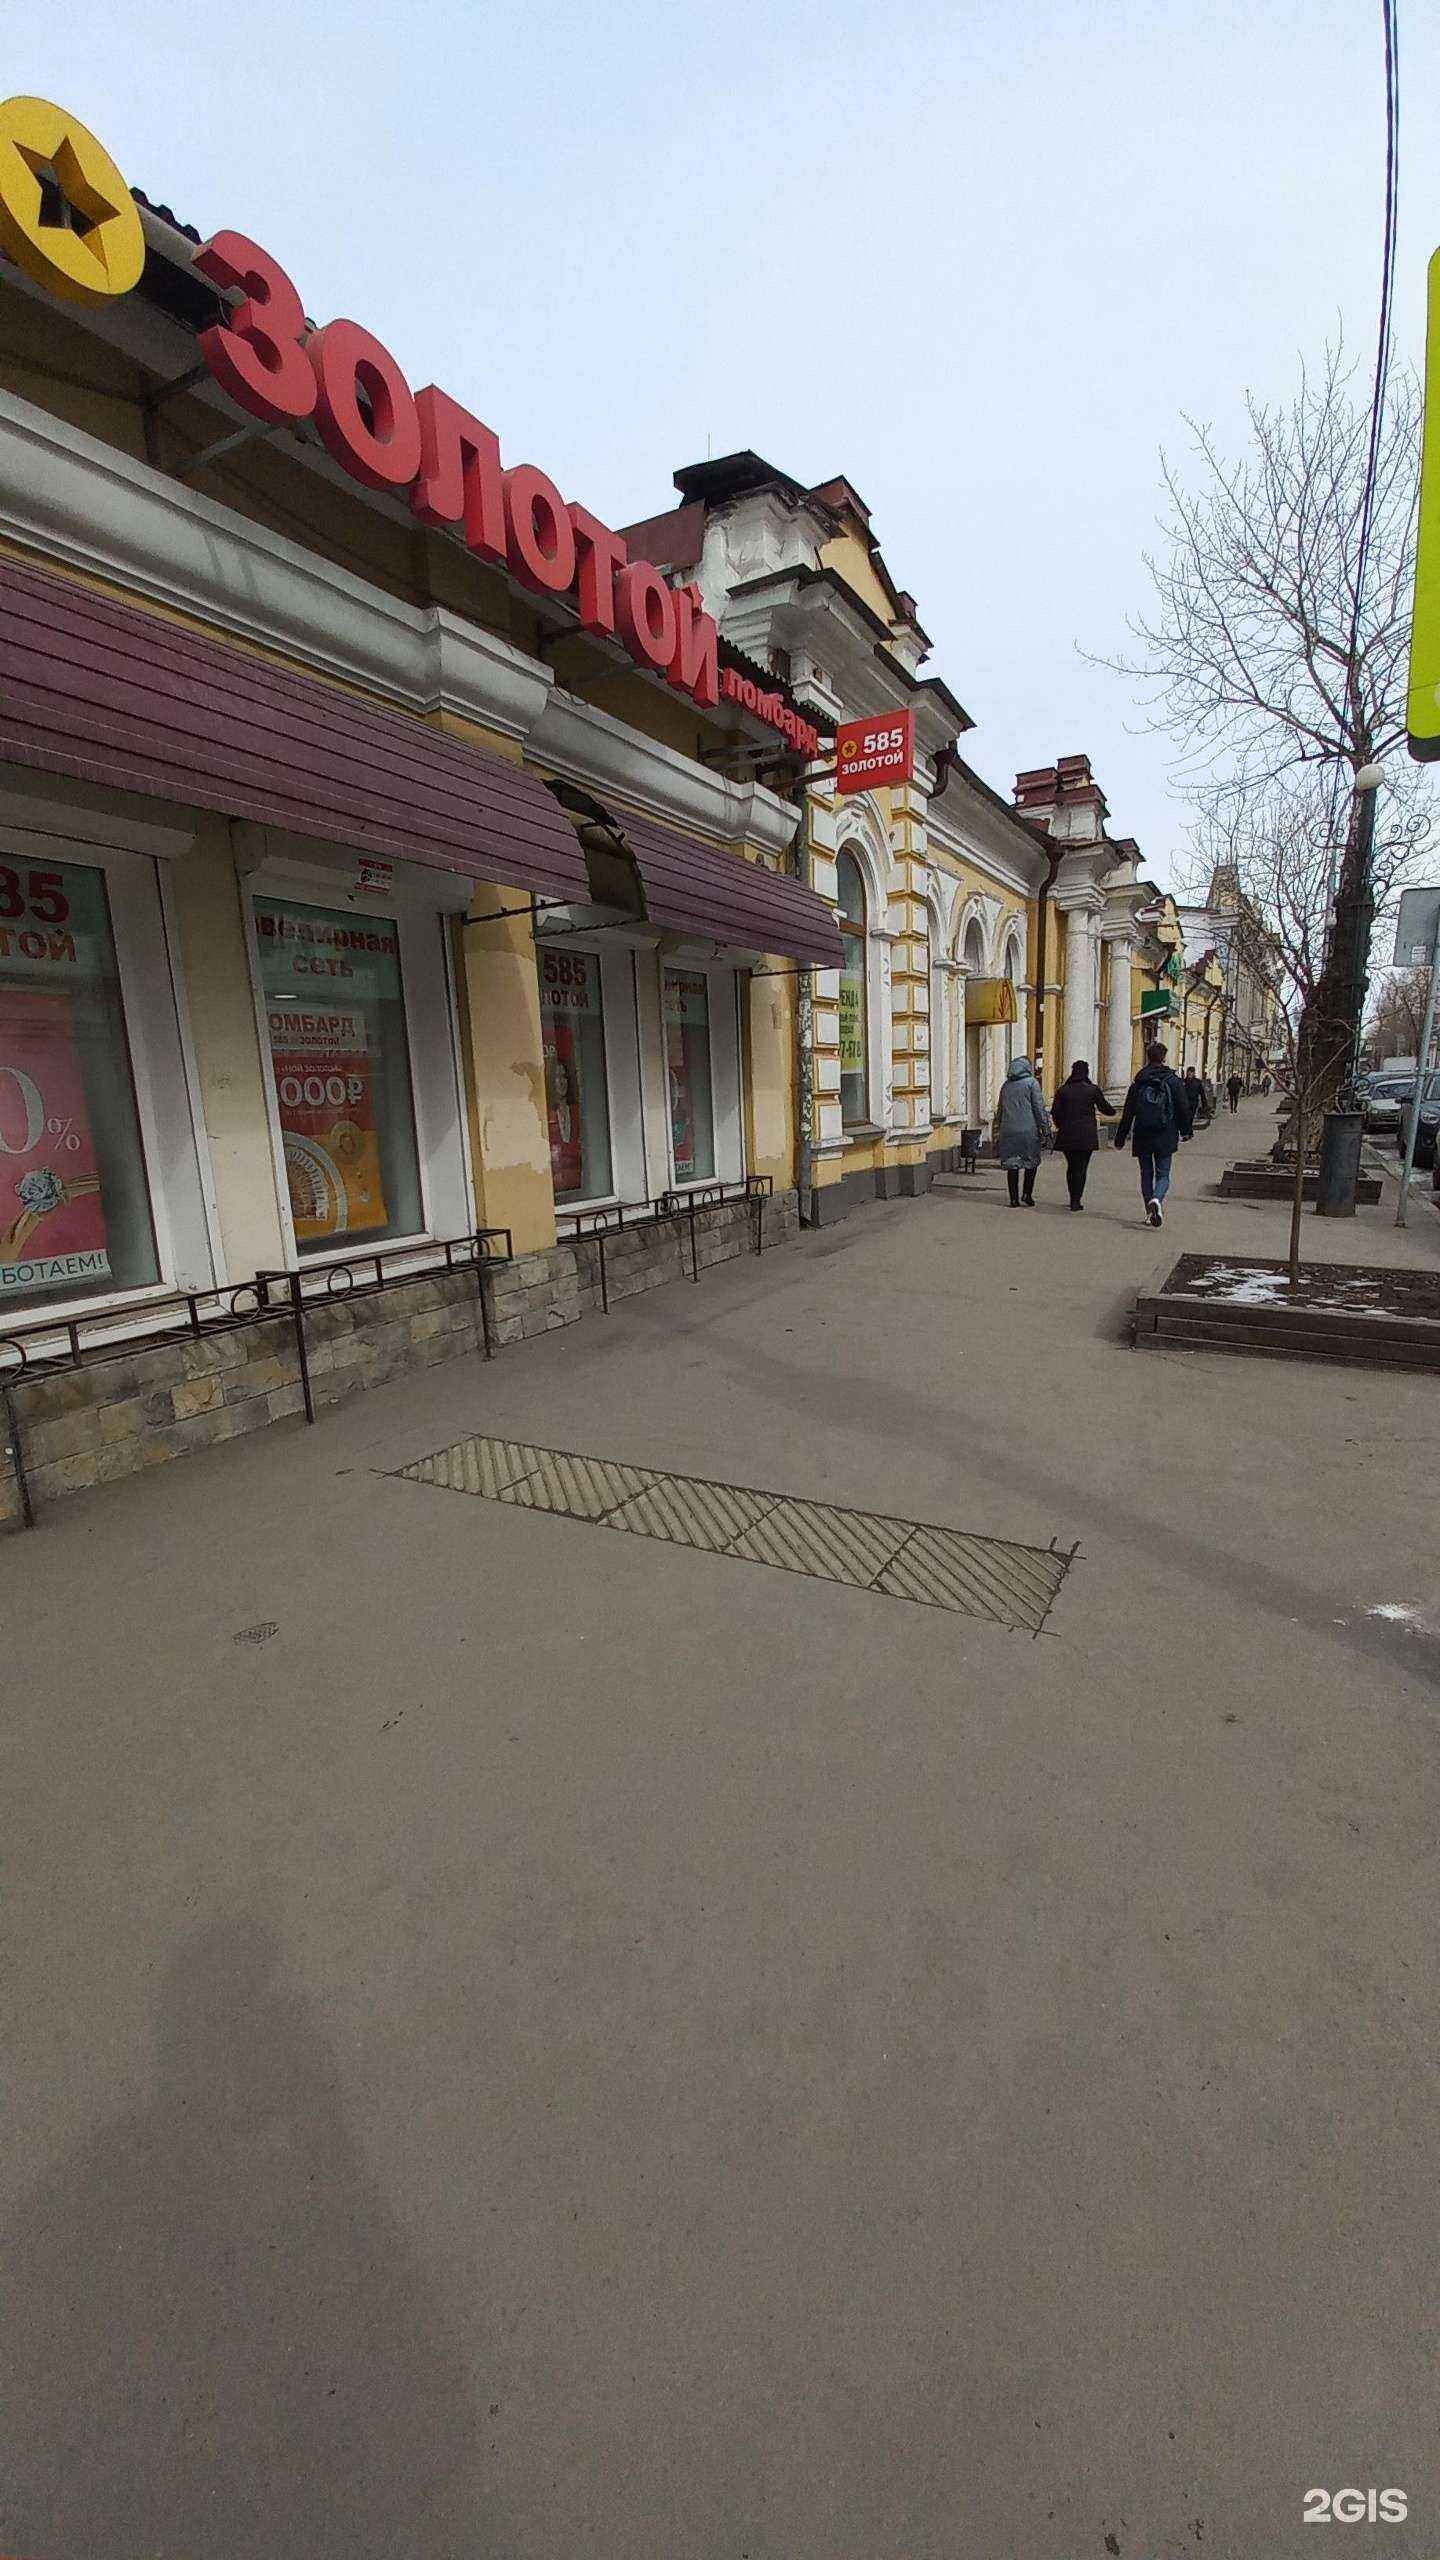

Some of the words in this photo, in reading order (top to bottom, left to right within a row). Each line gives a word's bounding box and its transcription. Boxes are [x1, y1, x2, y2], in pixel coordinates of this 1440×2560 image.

[863, 728, 904, 754] 585
[543, 952, 586, 986] 585
[1, 1253, 104, 1284] БОТАЕМ!
